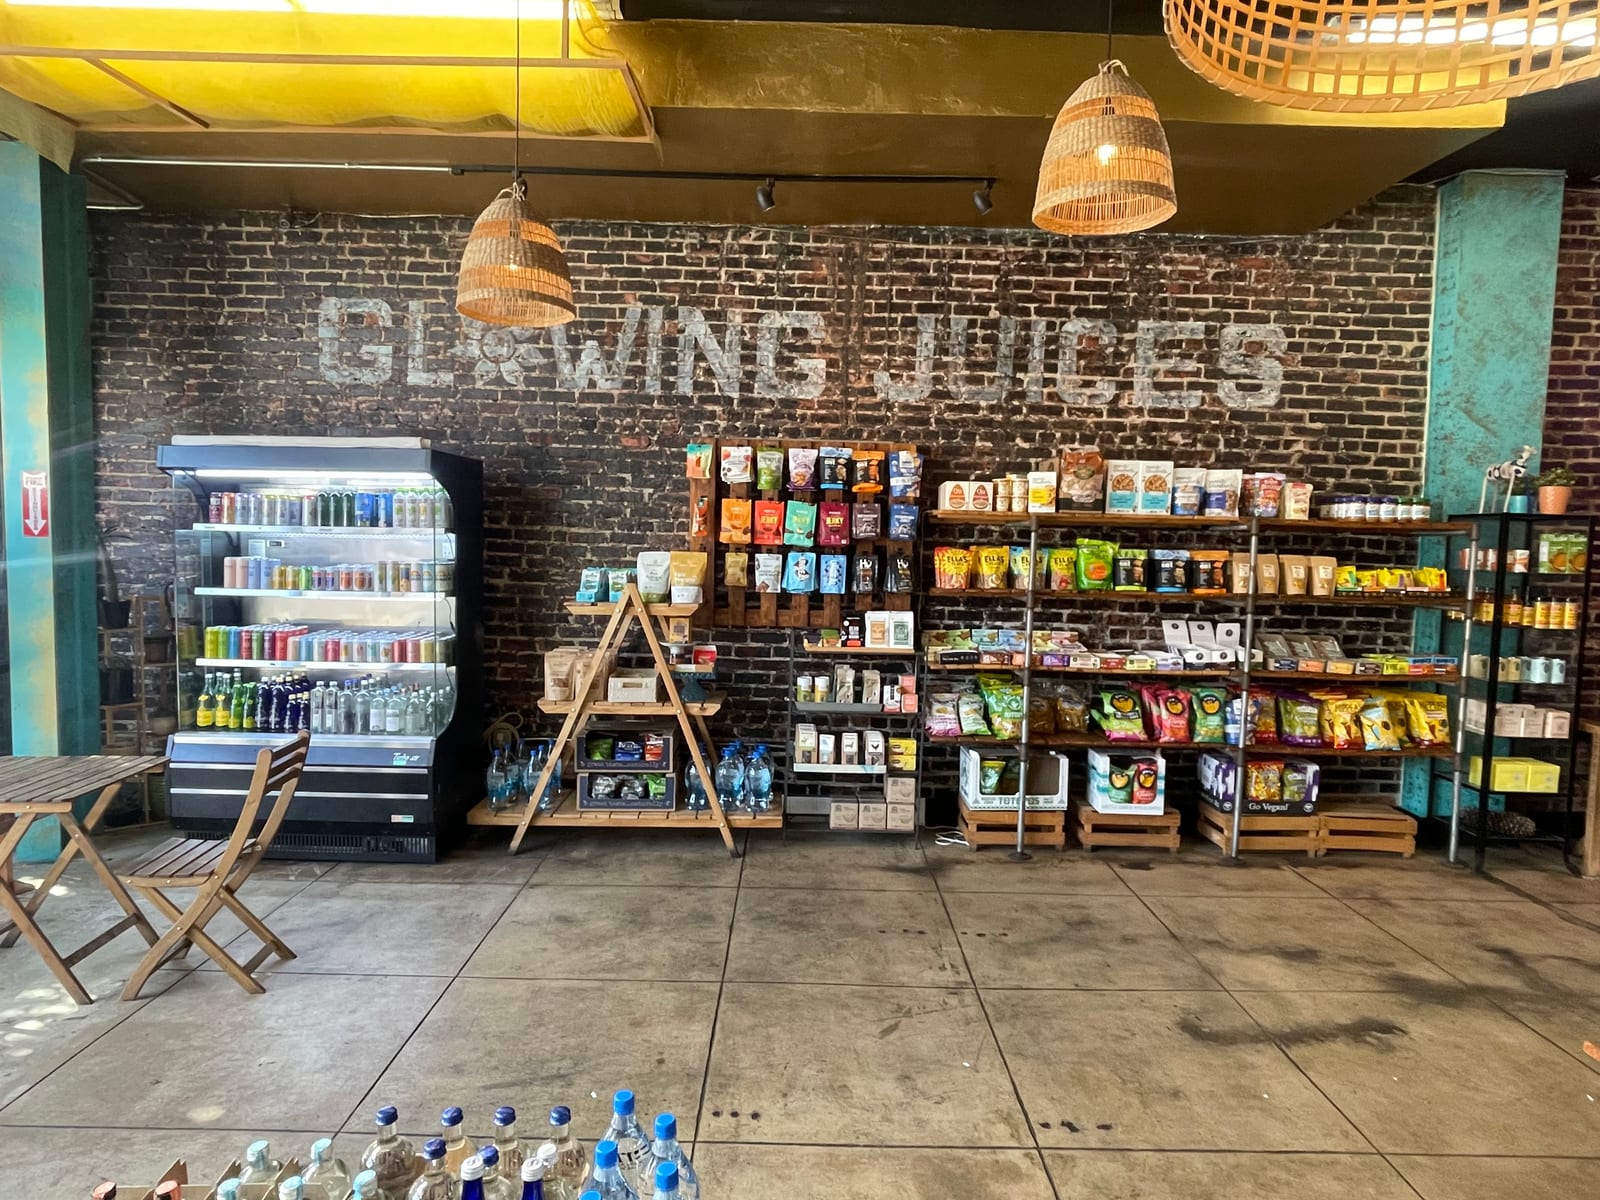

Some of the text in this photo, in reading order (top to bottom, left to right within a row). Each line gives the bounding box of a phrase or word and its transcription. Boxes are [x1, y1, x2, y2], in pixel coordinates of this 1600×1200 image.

[873, 314, 1289, 410] JUICES
[998, 797, 1040, 805] TOTOOS
[1248, 802, 1289, 813] Go Vegan!
